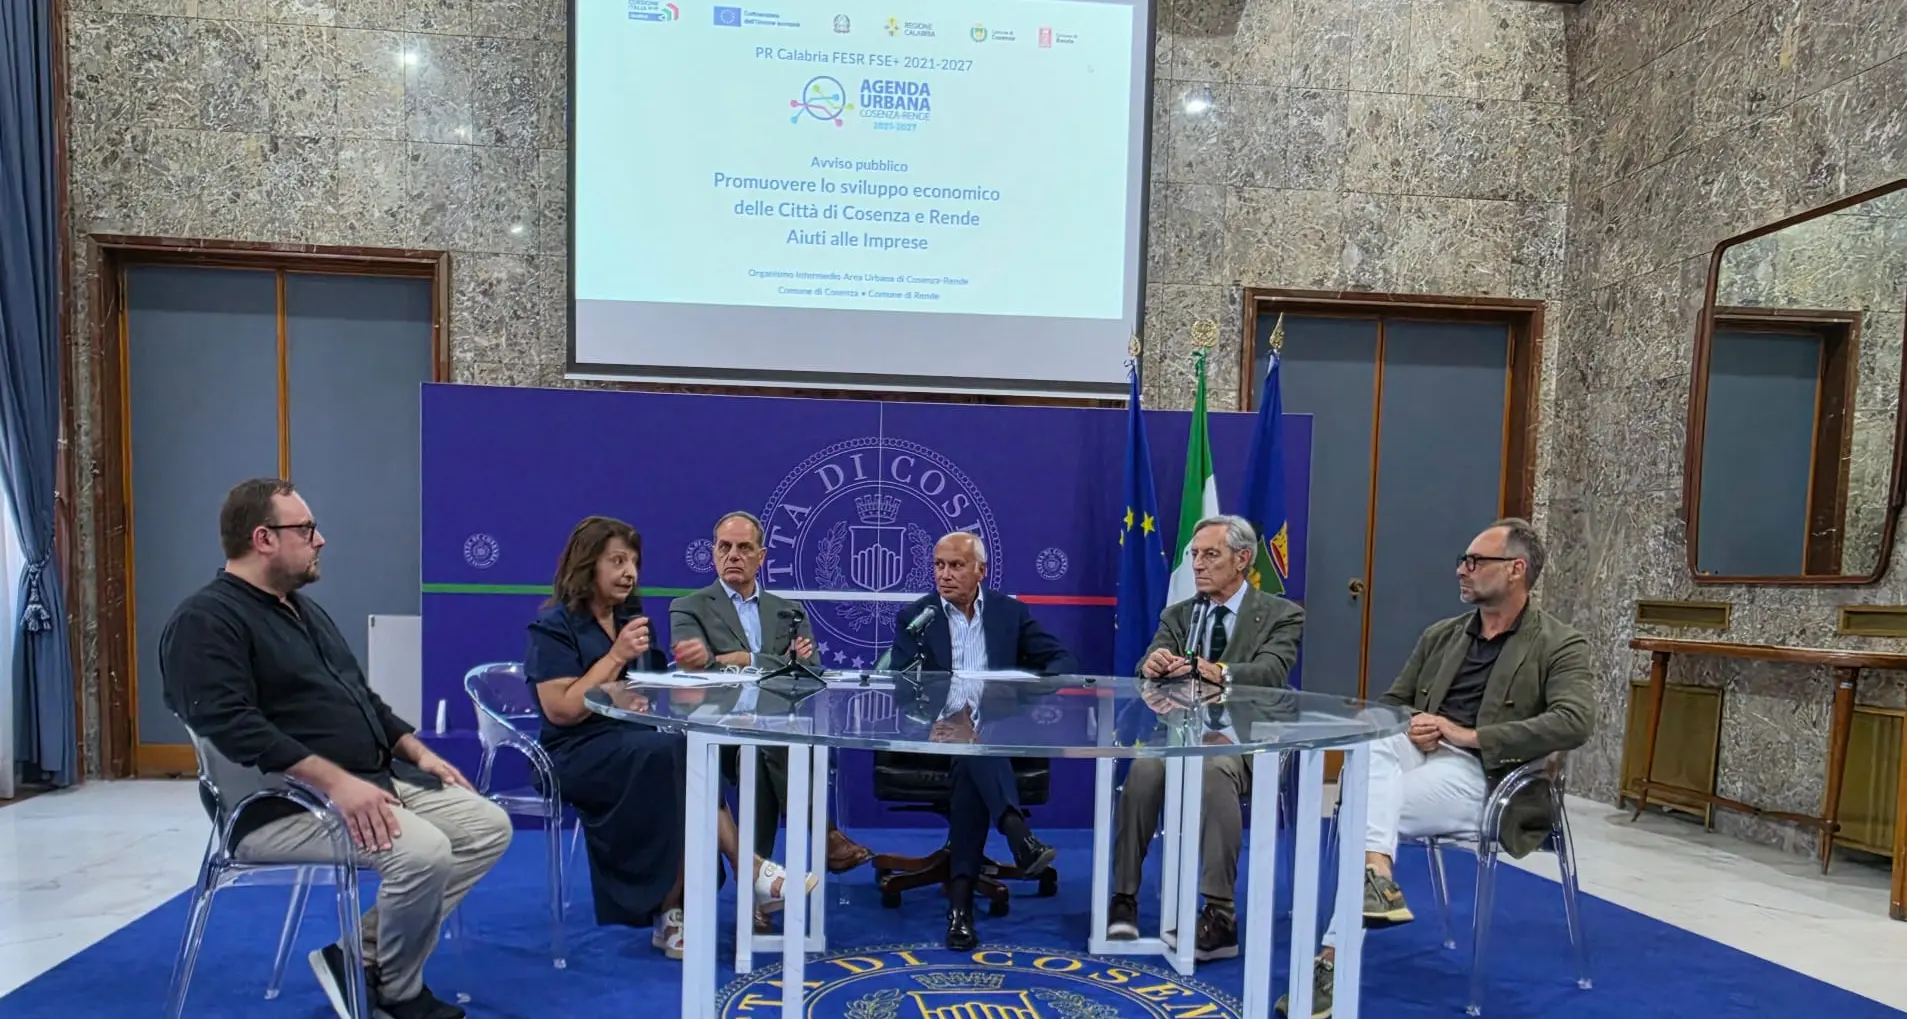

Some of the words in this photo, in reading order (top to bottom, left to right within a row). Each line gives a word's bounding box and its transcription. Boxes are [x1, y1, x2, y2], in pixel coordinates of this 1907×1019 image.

[755, 47, 774, 59] PR
[777, 48, 829, 63] Calabria
[832, 51, 865, 66] FESR
[868, 53, 900, 67] FSE+
[904, 56, 973, 72] 2021-2027
[860, 79, 931, 97] AGENDA
[860, 94, 931, 112] URBANA
[859, 109, 931, 121] COSENZA-RENDE
[810, 156, 852, 170] Avviso
[856, 159, 909, 172] pubblico
[713, 172, 816, 192] Promuovere
[820, 178, 836, 193] lo
[840, 179, 909, 200] sviluppo
[913, 185, 1000, 202] economico
[734, 200, 774, 217] delle
[778, 202, 818, 219] Città
[823, 204, 838, 220] di
[842, 206, 910, 223] Cosenza
[915, 212, 925, 224] e
[929, 209, 980, 226] Rende
[786, 229, 826, 246] Aiuti
[830, 231, 859, 247] alle
[863, 233, 928, 251] Imprese
[748, 268, 794, 279] Organismo
[796, 271, 841, 281] Intermedio
[843, 272, 863, 282] Area
[864, 273, 895, 283] Urbana
[896, 274, 904, 284] di
[778, 285, 812, 296] Comune
[814, 287, 823, 296] di
[824, 287, 859, 298] Cosenza
[868, 290, 902, 300] Comune
[904, 291, 912, 300] di
[914, 291, 940, 301] Rende
[766, 501, 812, 583] TTA
[814, 452, 868, 495] DI
[825, 950, 929, 975] DI
[970, 950, 1231, 1019] COSEN
